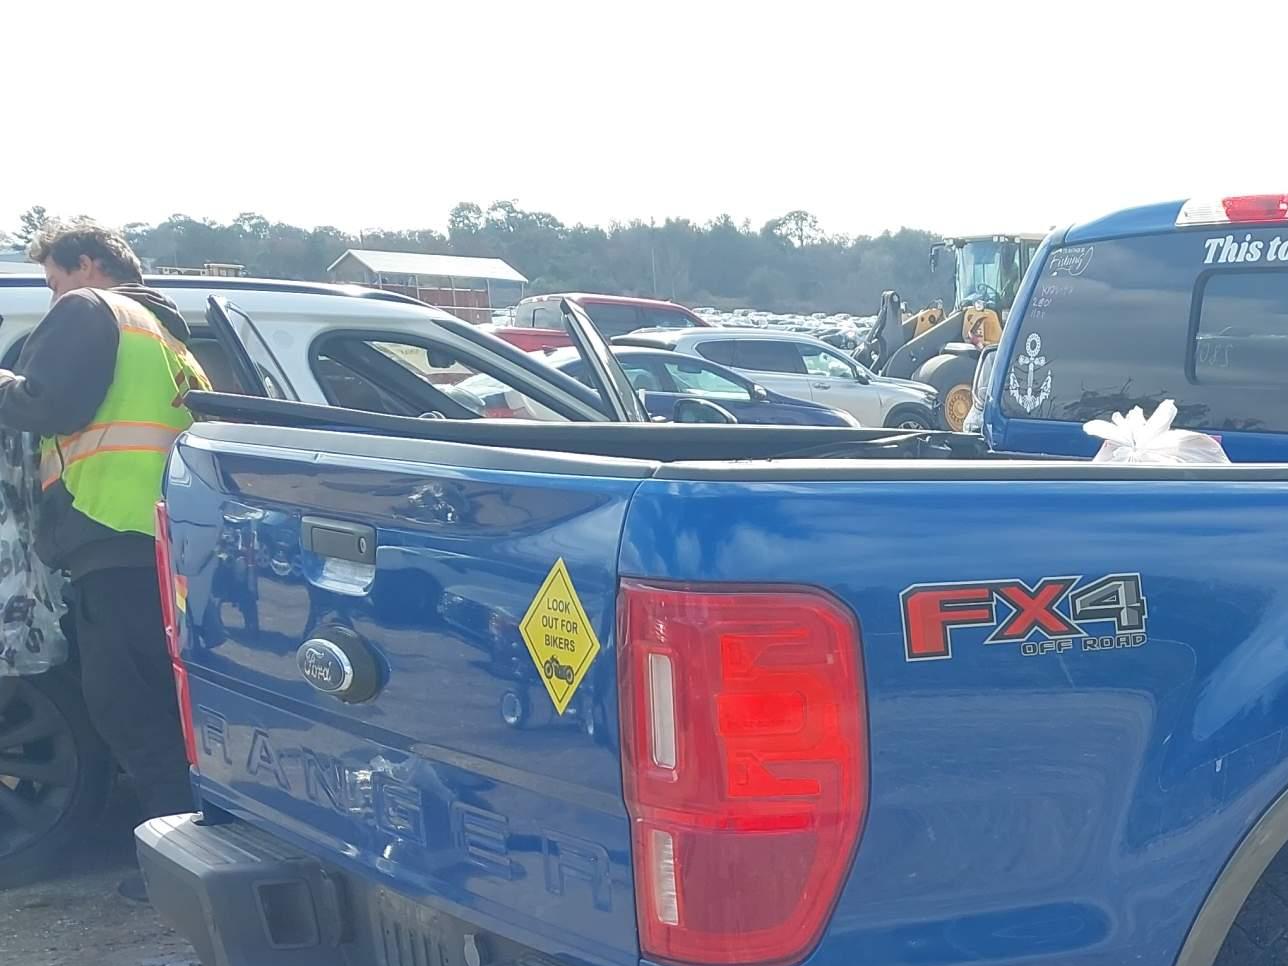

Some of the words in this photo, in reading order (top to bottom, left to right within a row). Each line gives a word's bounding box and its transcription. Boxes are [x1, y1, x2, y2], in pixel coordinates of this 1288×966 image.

[1203, 234, 1263, 264] This
[547, 598, 570, 613] LOOK
[899, 573, 1148, 662] FX4
[541, 615, 559, 630] OUT
[560, 619, 578, 635] FOR
[544, 634, 576, 652] BIKERS
[1020, 638, 1073, 656] OFF
[1081, 633, 1148, 651] ROAD
[304, 647, 332, 682] Ford
[198, 703, 613, 914] RANGER
